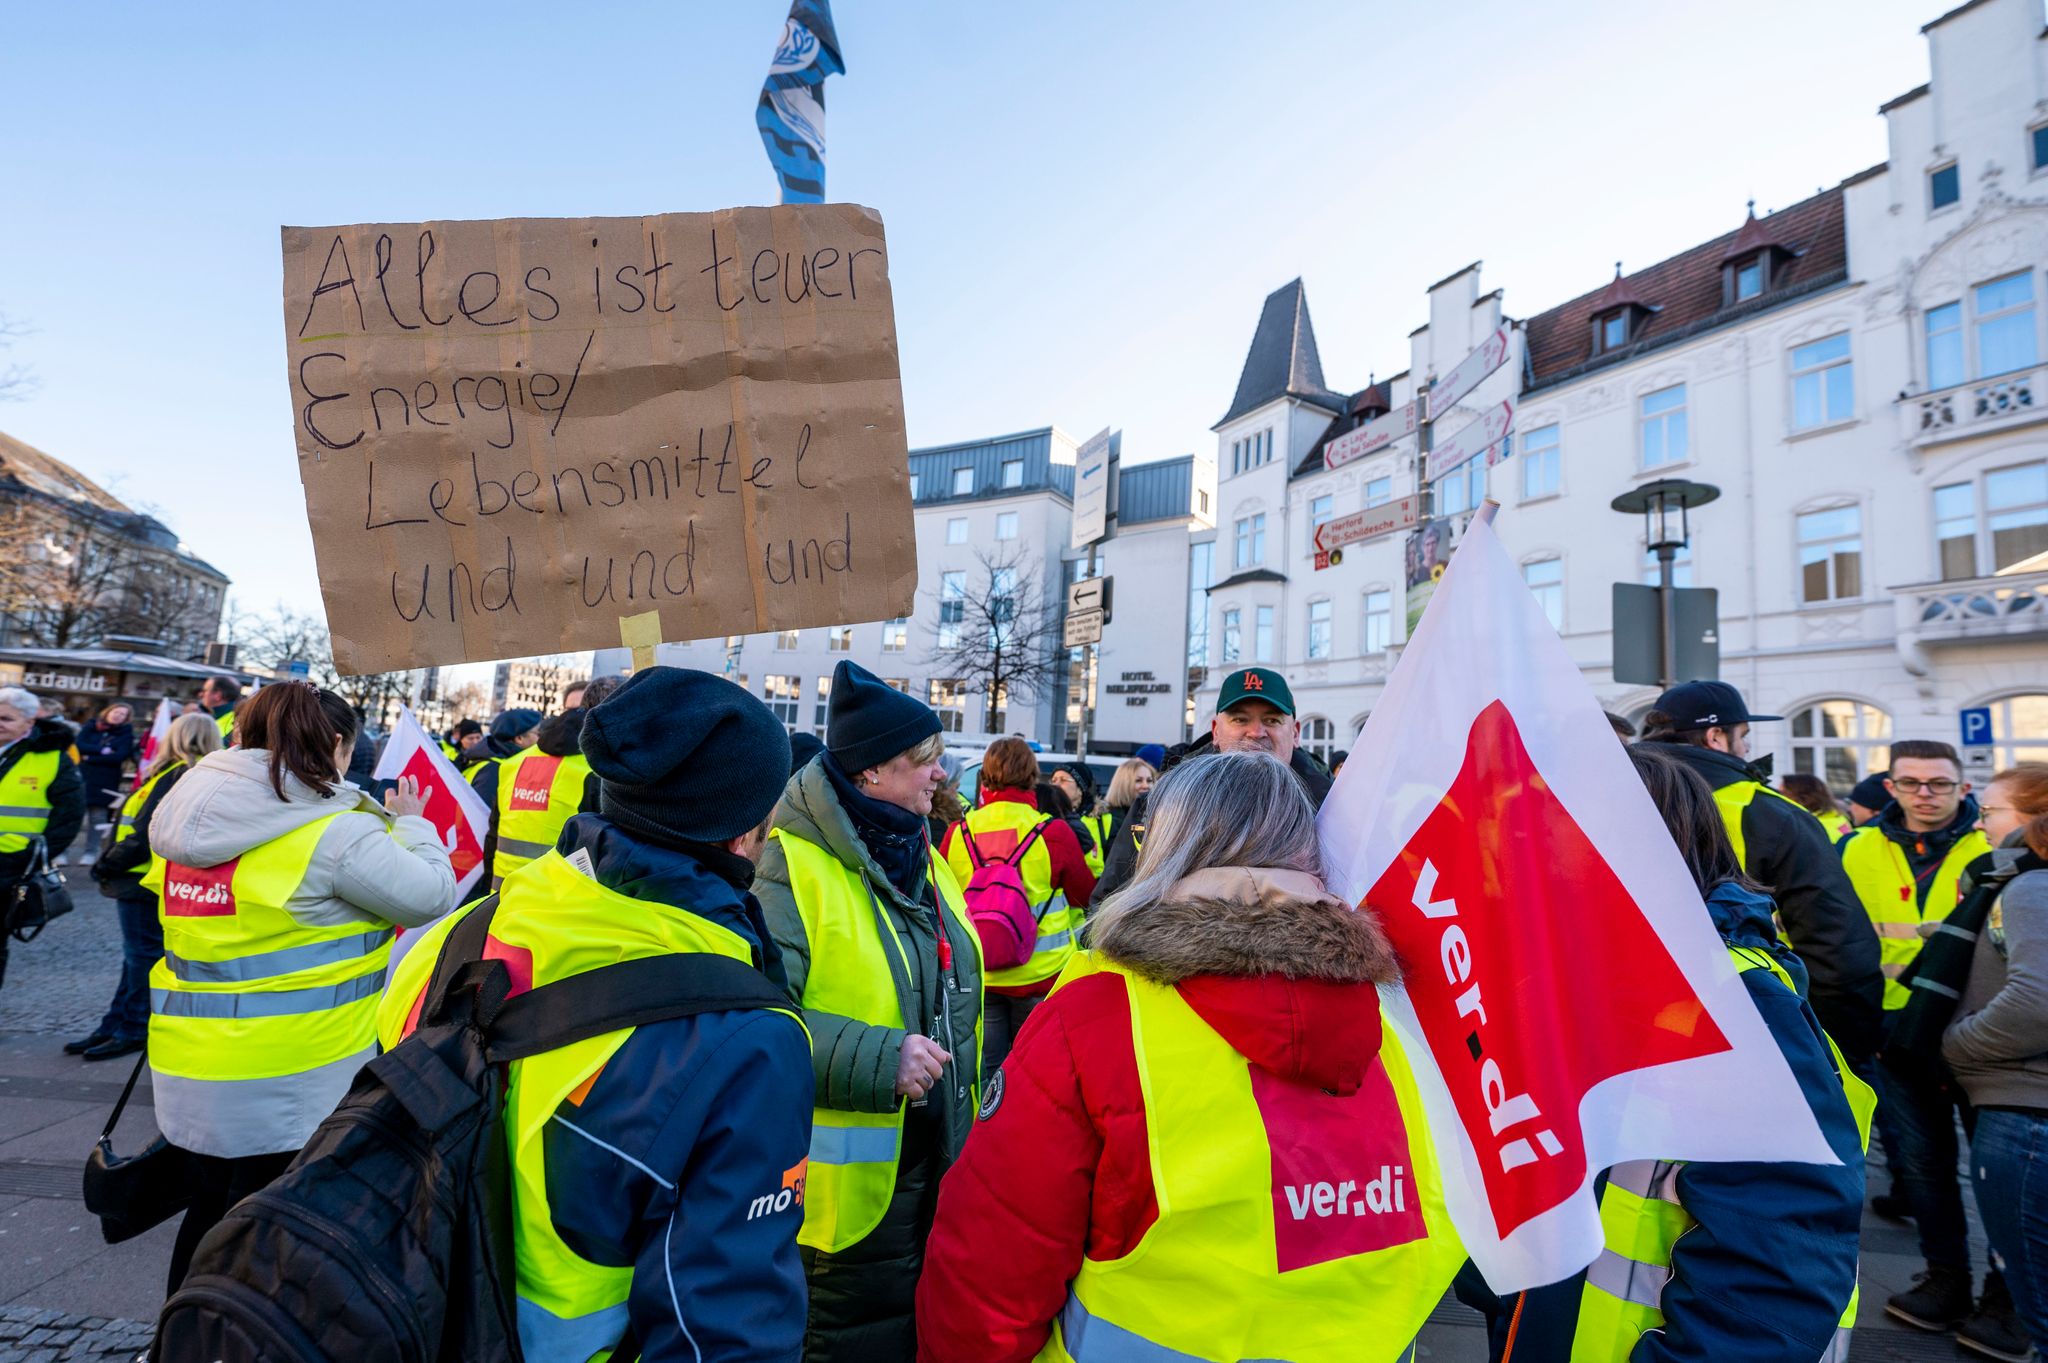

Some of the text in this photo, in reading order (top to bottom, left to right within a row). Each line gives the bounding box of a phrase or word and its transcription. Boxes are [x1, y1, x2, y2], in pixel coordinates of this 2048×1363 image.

[299, 229, 882, 336] Alles ist teuer
[366, 424, 818, 530] Lebensmittel
[1331, 516, 1363, 532] Herford
[392, 512, 853, 622] und und und
[1106, 684, 1171, 694] BIELEFELDER
[1121, 672, 1155, 681] HOTEL
[1244, 671, 1263, 691] LA
[1126, 697, 1148, 706] HOF
[1966, 712, 1986, 741] P
[513, 786, 549, 804] ver.di
[167, 880, 229, 905] ver.di
[1411, 857, 1564, 1174] ver.di
[1284, 1165, 1406, 1220] ver.di
